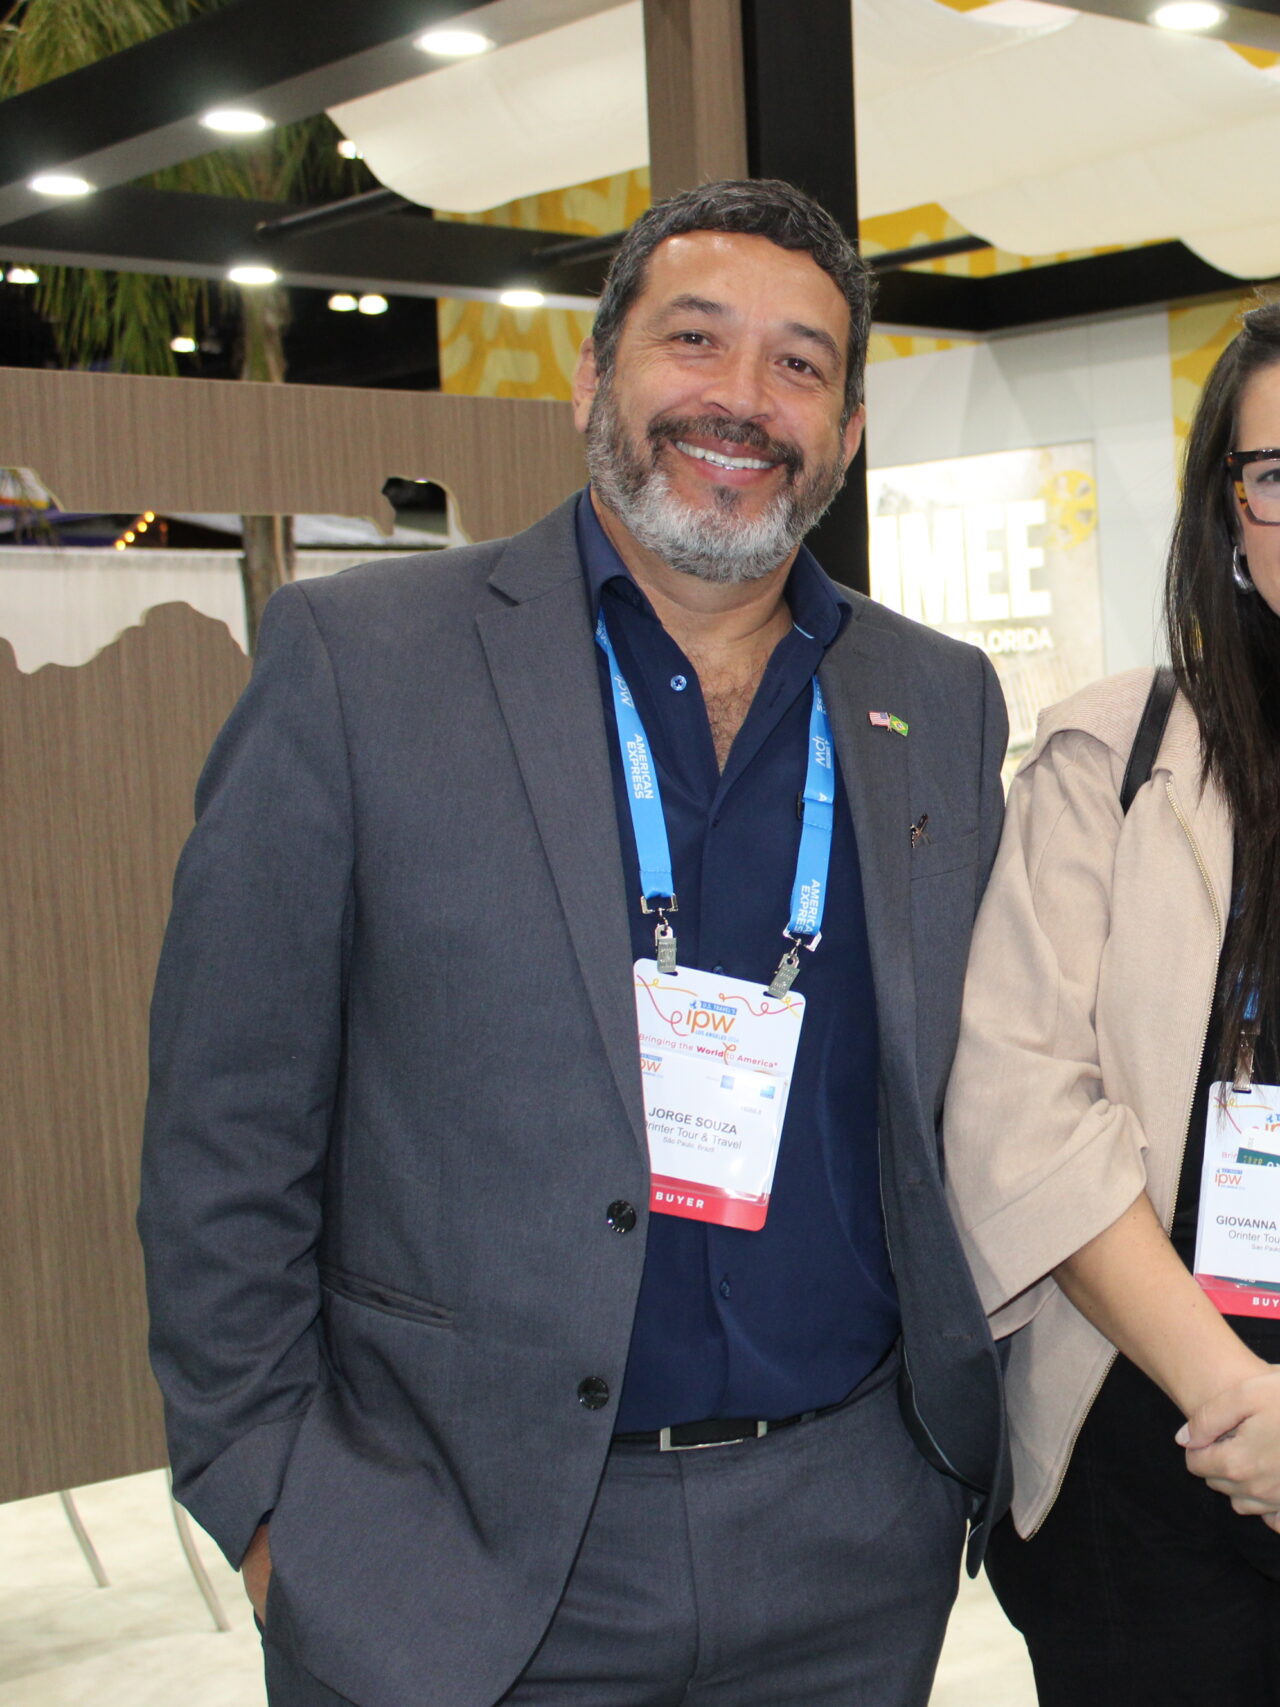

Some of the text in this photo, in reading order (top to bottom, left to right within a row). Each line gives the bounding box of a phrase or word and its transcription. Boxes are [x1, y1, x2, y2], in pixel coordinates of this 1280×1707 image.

[811, 735, 826, 768] ipw
[627, 741, 644, 799] EXPRESS
[634, 733, 654, 799] AMERICAN
[794, 885, 810, 932] EXPRES
[805, 879, 821, 932] AMERICA
[686, 1009, 736, 1033] ipw
[639, 1033, 677, 1048] Bringing
[679, 1041, 694, 1051] the
[696, 1046, 724, 1058] World
[648, 1107, 738, 1135] JORGE SOUZA
[677, 1126, 698, 1140] Tour
[701, 1132, 708, 1143] &
[712, 1135, 742, 1150] Travel
[1215, 1173, 1242, 1187] ipw
[655, 1191, 705, 1209] BUYER
[1216, 1215, 1277, 1231] GIOVANNA
[1228, 1229, 1260, 1242] Orinter
